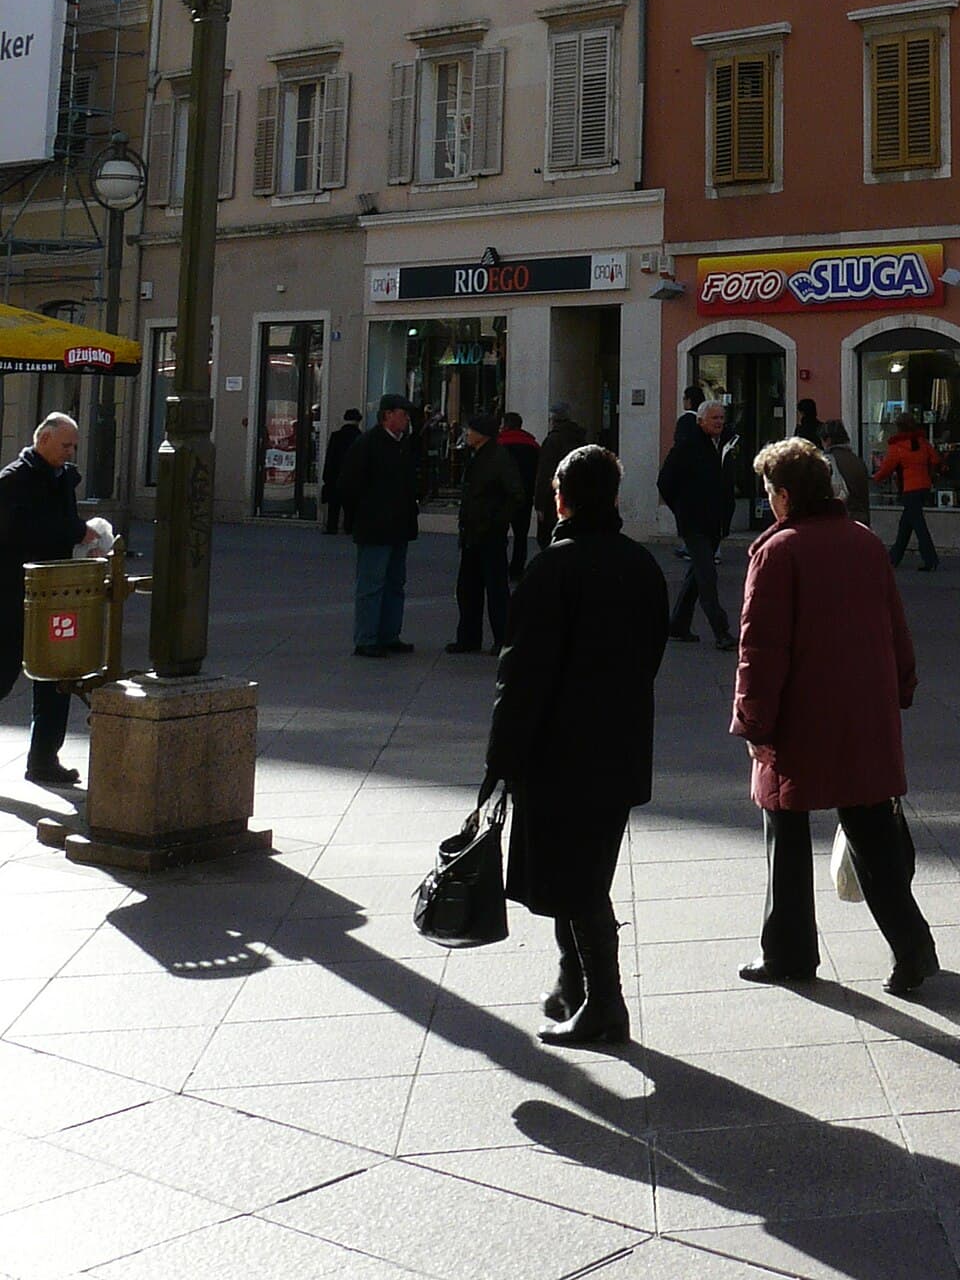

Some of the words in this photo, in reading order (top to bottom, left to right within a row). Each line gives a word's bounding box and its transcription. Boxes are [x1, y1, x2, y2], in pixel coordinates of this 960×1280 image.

[0, 31, 34, 60] ker
[701, 270, 783, 303] FOTO
[811, 254, 931, 298] SLUGA
